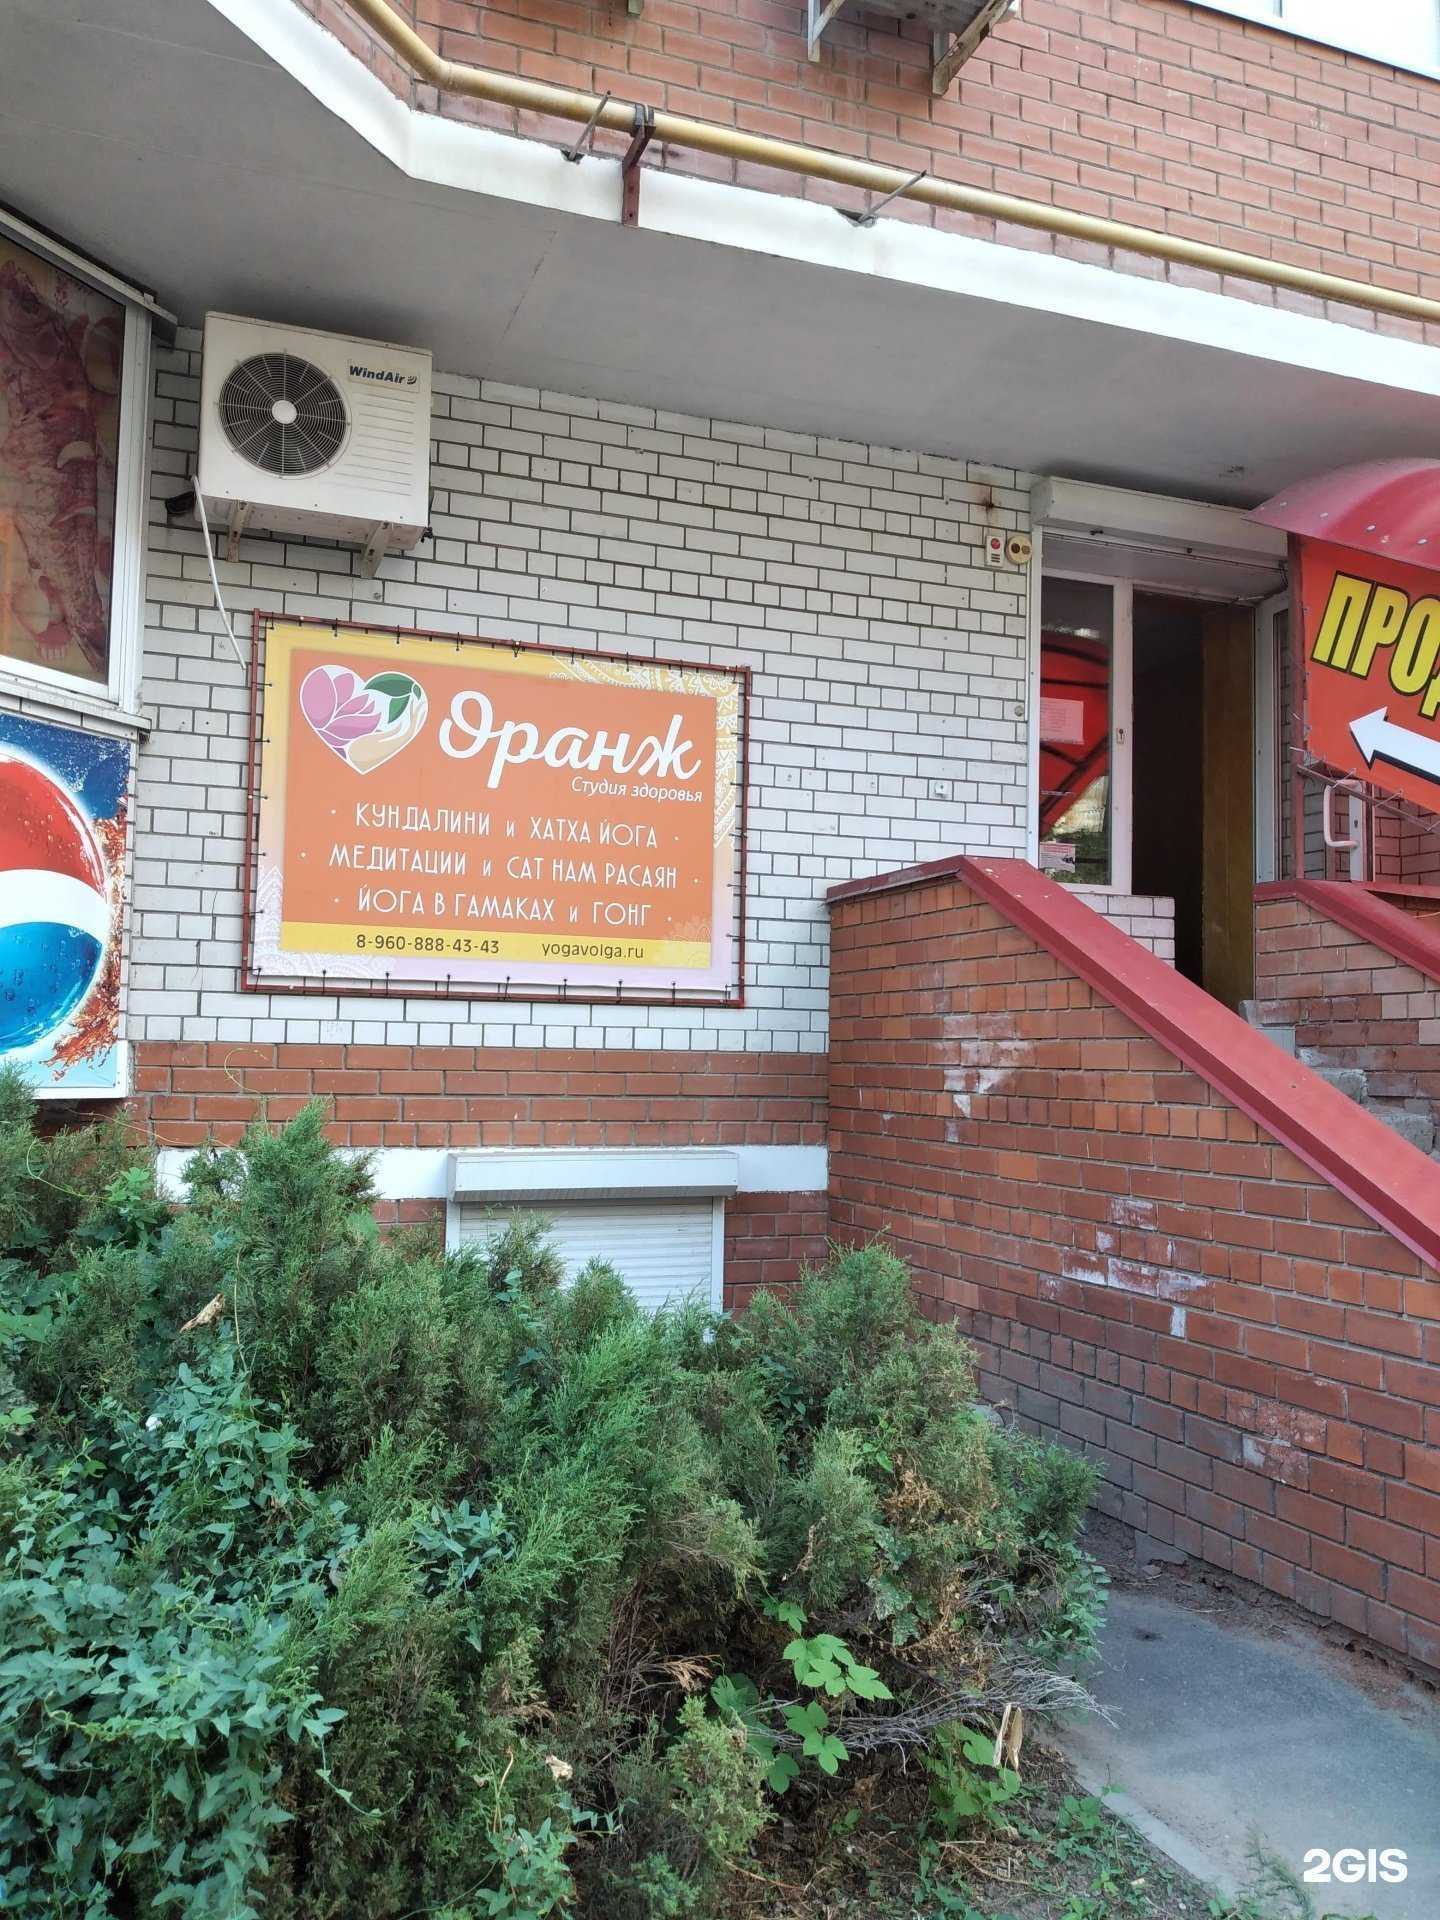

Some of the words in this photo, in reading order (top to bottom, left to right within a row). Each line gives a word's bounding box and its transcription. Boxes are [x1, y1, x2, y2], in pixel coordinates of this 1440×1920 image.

[349, 365, 405, 384] WindAir
[1311, 570, 1440, 721] ПРО
[439, 690, 702, 789] Оранж
[570, 776, 627, 797] Студия
[631, 783, 703, 803] здоровья
[355, 803, 490, 836] КУНДАЛИНИ
[506, 820, 515, 837] и
[530, 816, 591, 844] ХАТХА
[599, 818, 658, 848] ЙОГА
[329, 843, 466, 875] МЕДИТАЦИИ
[483, 860, 492, 877] и
[507, 856, 544, 880] САТ
[552, 858, 597, 884] НАМ
[605, 862, 677, 889] РАСАЯН
[358, 883, 425, 915] ЙОГА
[434, 892, 445, 915] В
[454, 894, 555, 921] ГАМАКАХ
[569, 905, 578, 923] и
[592, 901, 651, 927] ГОНГ
[356, 934, 500, 954] 8-960-888-43-43
[541, 941, 645, 960] yogavolga.ru
